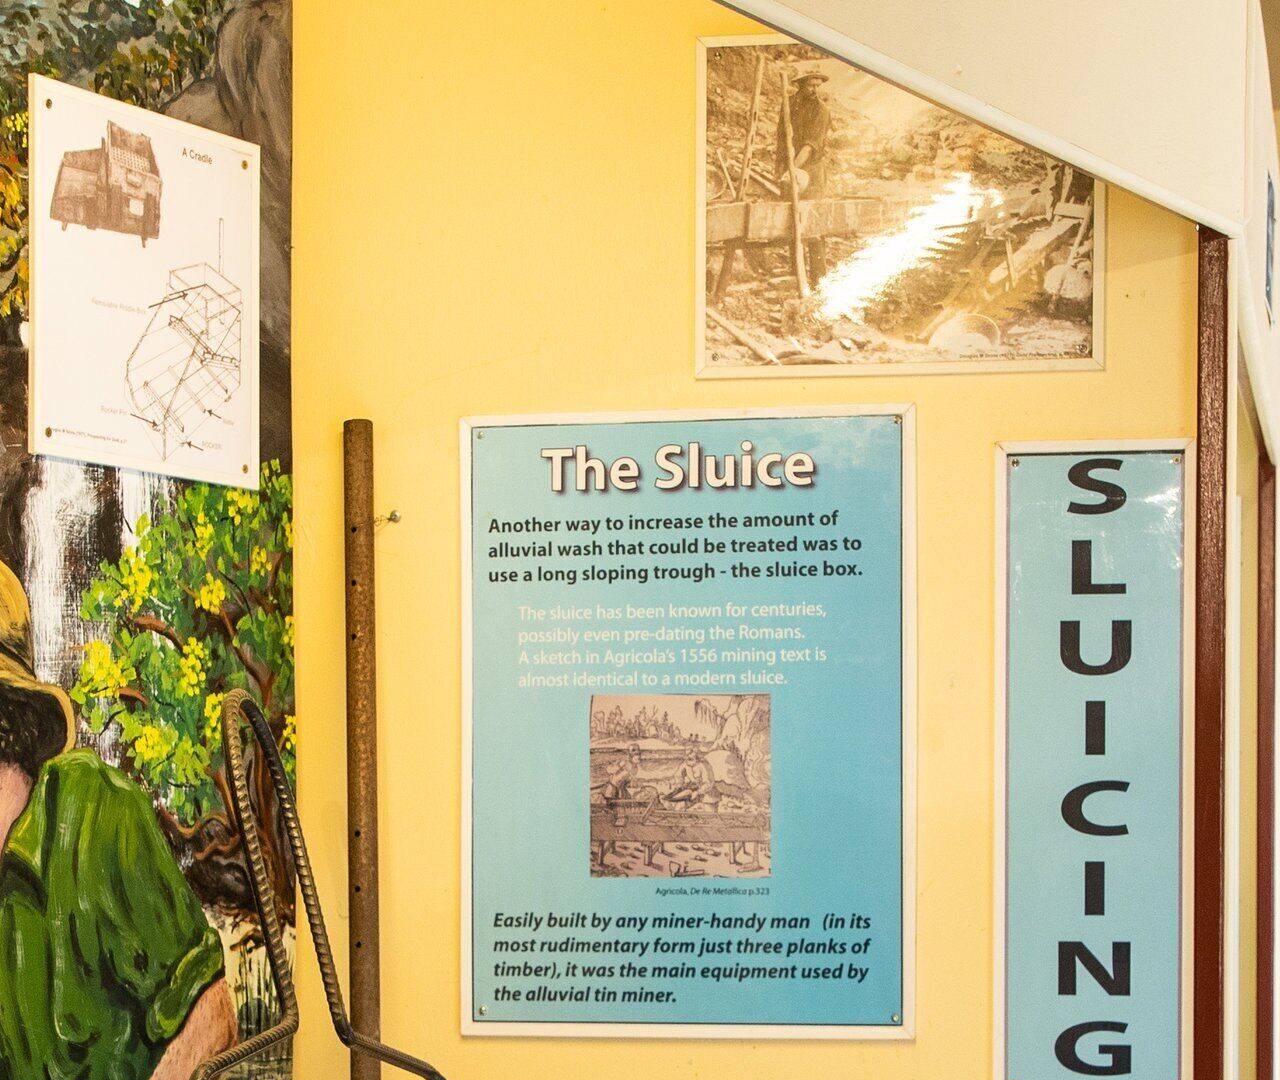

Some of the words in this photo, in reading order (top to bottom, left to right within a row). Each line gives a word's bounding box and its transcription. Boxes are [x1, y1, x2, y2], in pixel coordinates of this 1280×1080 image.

[182, 148, 188, 158] A
[189, 149, 213, 165] Cradle
[540, 445, 640, 491] The
[654, 440, 815, 490] Sluice
[488, 516, 561, 533] Another
[565, 519, 601, 534] way
[605, 517, 624, 531] to
[628, 514, 703, 530] increase
[707, 512, 738, 528] the
[742, 512, 815, 527] amount
[819, 509, 839, 526] of
[488, 541, 552, 558] alluvial
[557, 540, 602, 556] wash
[607, 539, 644, 555] that
[648, 537, 698, 554] could
[703, 537, 726, 553] be
[730, 535, 797, 552] treated
[802, 539, 838, 551] was
[842, 536, 862, 550] to
[488, 570, 518, 582] use
[522, 570, 532, 582] a
[537, 566, 577, 585] long
[582, 564, 648, 584] sloping
[653, 562, 715, 583] trough
[730, 562, 761, 578] the
[765, 561, 818, 577] sluice
[822, 560, 863, 576] box.
[517, 606, 546, 620] The
[550, 605, 592, 620] sluice
[596, 604, 622, 619] has
[626, 603, 665, 619] been
[668, 603, 722, 618] known
[725, 601, 748, 617] for
[750, 601, 827, 617] centuries,
[518, 627, 580, 645] possibly
[583, 630, 620, 642] even
[624, 625, 705, 644] pre-dating
[708, 624, 736, 640] the
[738, 624, 805, 640] Romans.
[518, 650, 529, 664] A
[533, 649, 581, 664] sketch
[585, 649, 599, 664] in
[603, 648, 676, 667] Agricola's
[681, 648, 718, 664] 1556
[721, 647, 776, 666] mining
[780, 646, 811, 662] text
[814, 645, 827, 662] is
[518, 672, 569, 687] almost
[572, 670, 637, 686] identical
[641, 673, 658, 686] to
[661, 671, 672, 686] a
[674, 670, 736, 685] modern
[739, 669, 788, 685] sluice.
[1053, 457, 1133, 1076] SLUICING
[493, 912, 543, 931] Easily
[546, 912, 587, 928] built
[590, 912, 612, 932] by
[615, 916, 648, 932] any
[651, 912, 767, 932] miner-handy
[769, 917, 810, 929] man
[822, 912, 845, 931] (in
[849, 913, 871, 929] its
[493, 939, 537, 952] most
[539, 937, 650, 957] rudimentary
[653, 937, 695, 953] form
[697, 937, 733, 957] just
[736, 937, 783, 954] three
[786, 937, 847, 957] planks
[850, 937, 872, 954] of
[493, 961, 561, 979] timber),
[565, 961, 578, 977] it
[581, 965, 615, 977] was
[619, 961, 648, 978] the
[651, 962, 696, 978] main
[700, 962, 797, 981] equipment
[800, 963, 844, 979] used
[847, 962, 869, 981] by
[494, 985, 522, 1001] the
[525, 985, 591, 1002] alluvial
[594, 986, 617, 1002] tin
[621, 986, 676, 1003] miner.
